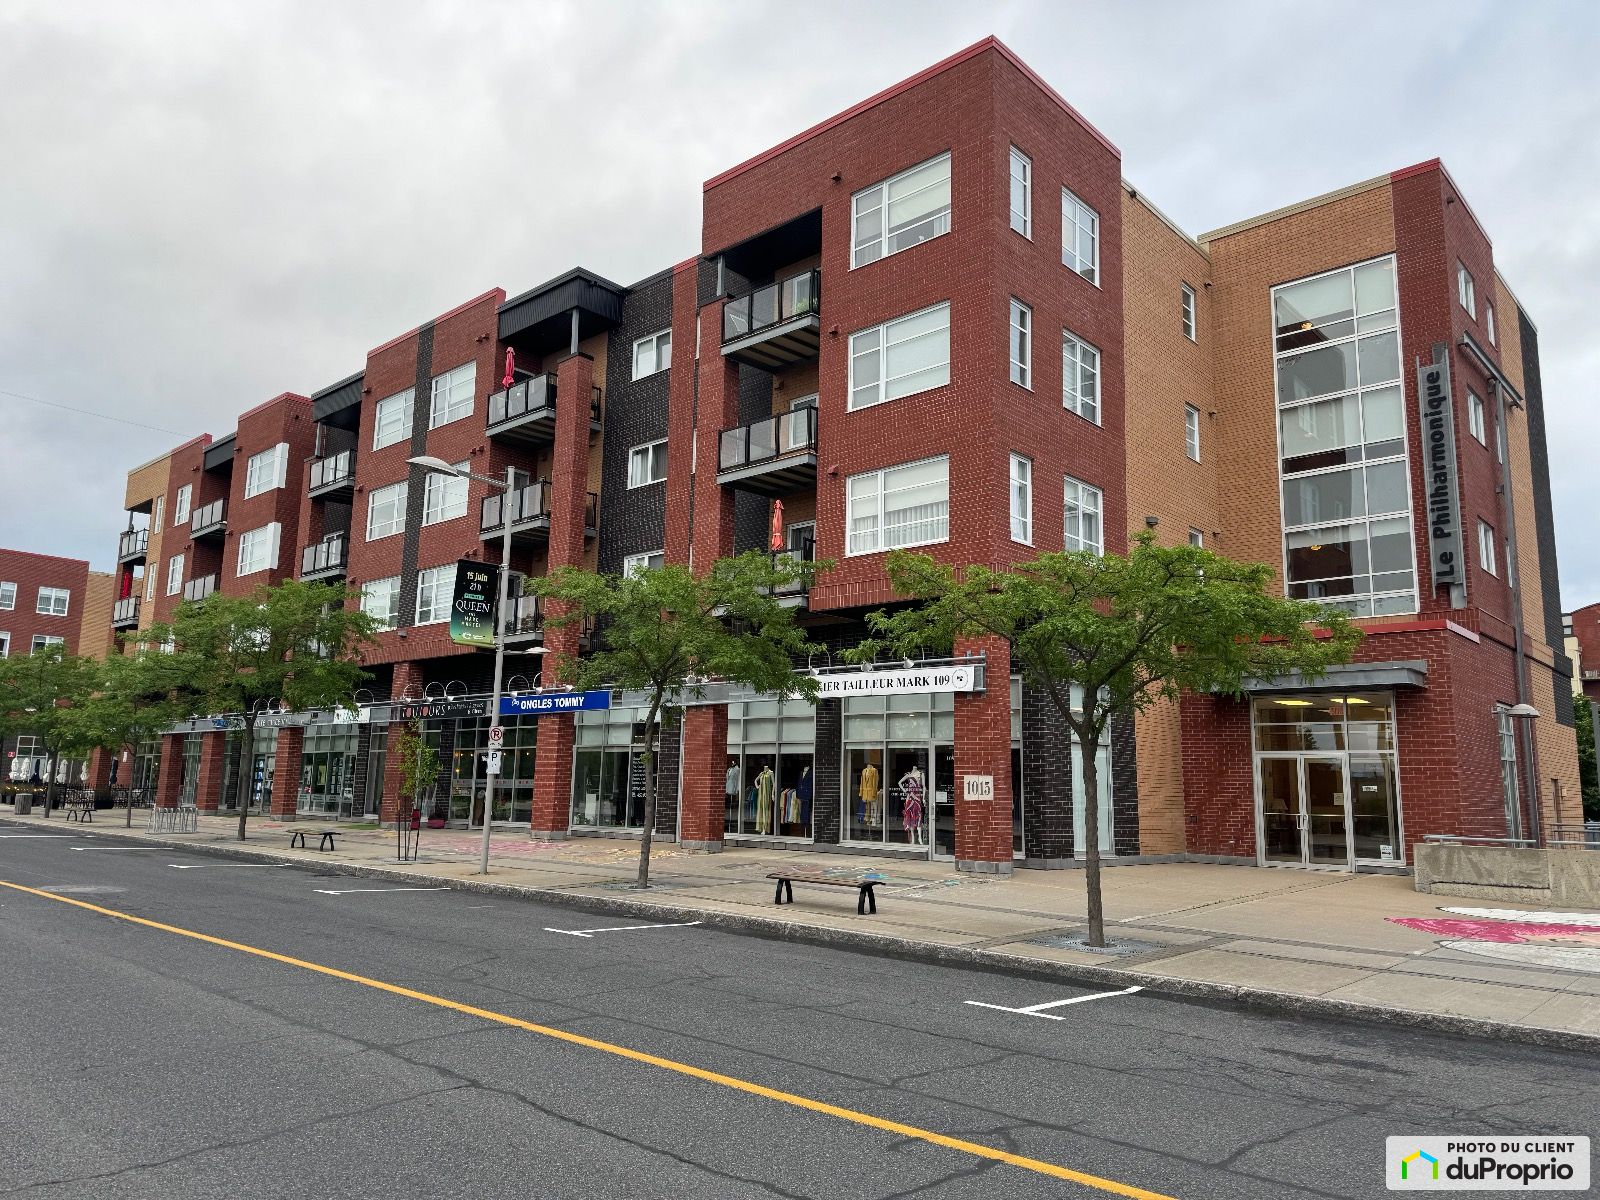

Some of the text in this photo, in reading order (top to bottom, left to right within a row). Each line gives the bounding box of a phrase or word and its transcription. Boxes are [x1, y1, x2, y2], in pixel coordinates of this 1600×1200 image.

[1424, 370, 1454, 578] Le Philharmonique
[467, 571, 474, 580] 15
[455, 599, 490, 613] QUEEN
[842, 676, 894, 691] TAILLEUR
[896, 675, 931, 688] MARK
[934, 674, 950, 686] 109
[520, 696, 584, 710] ONGLES TOMMY
[966, 780, 991, 796] 1015
